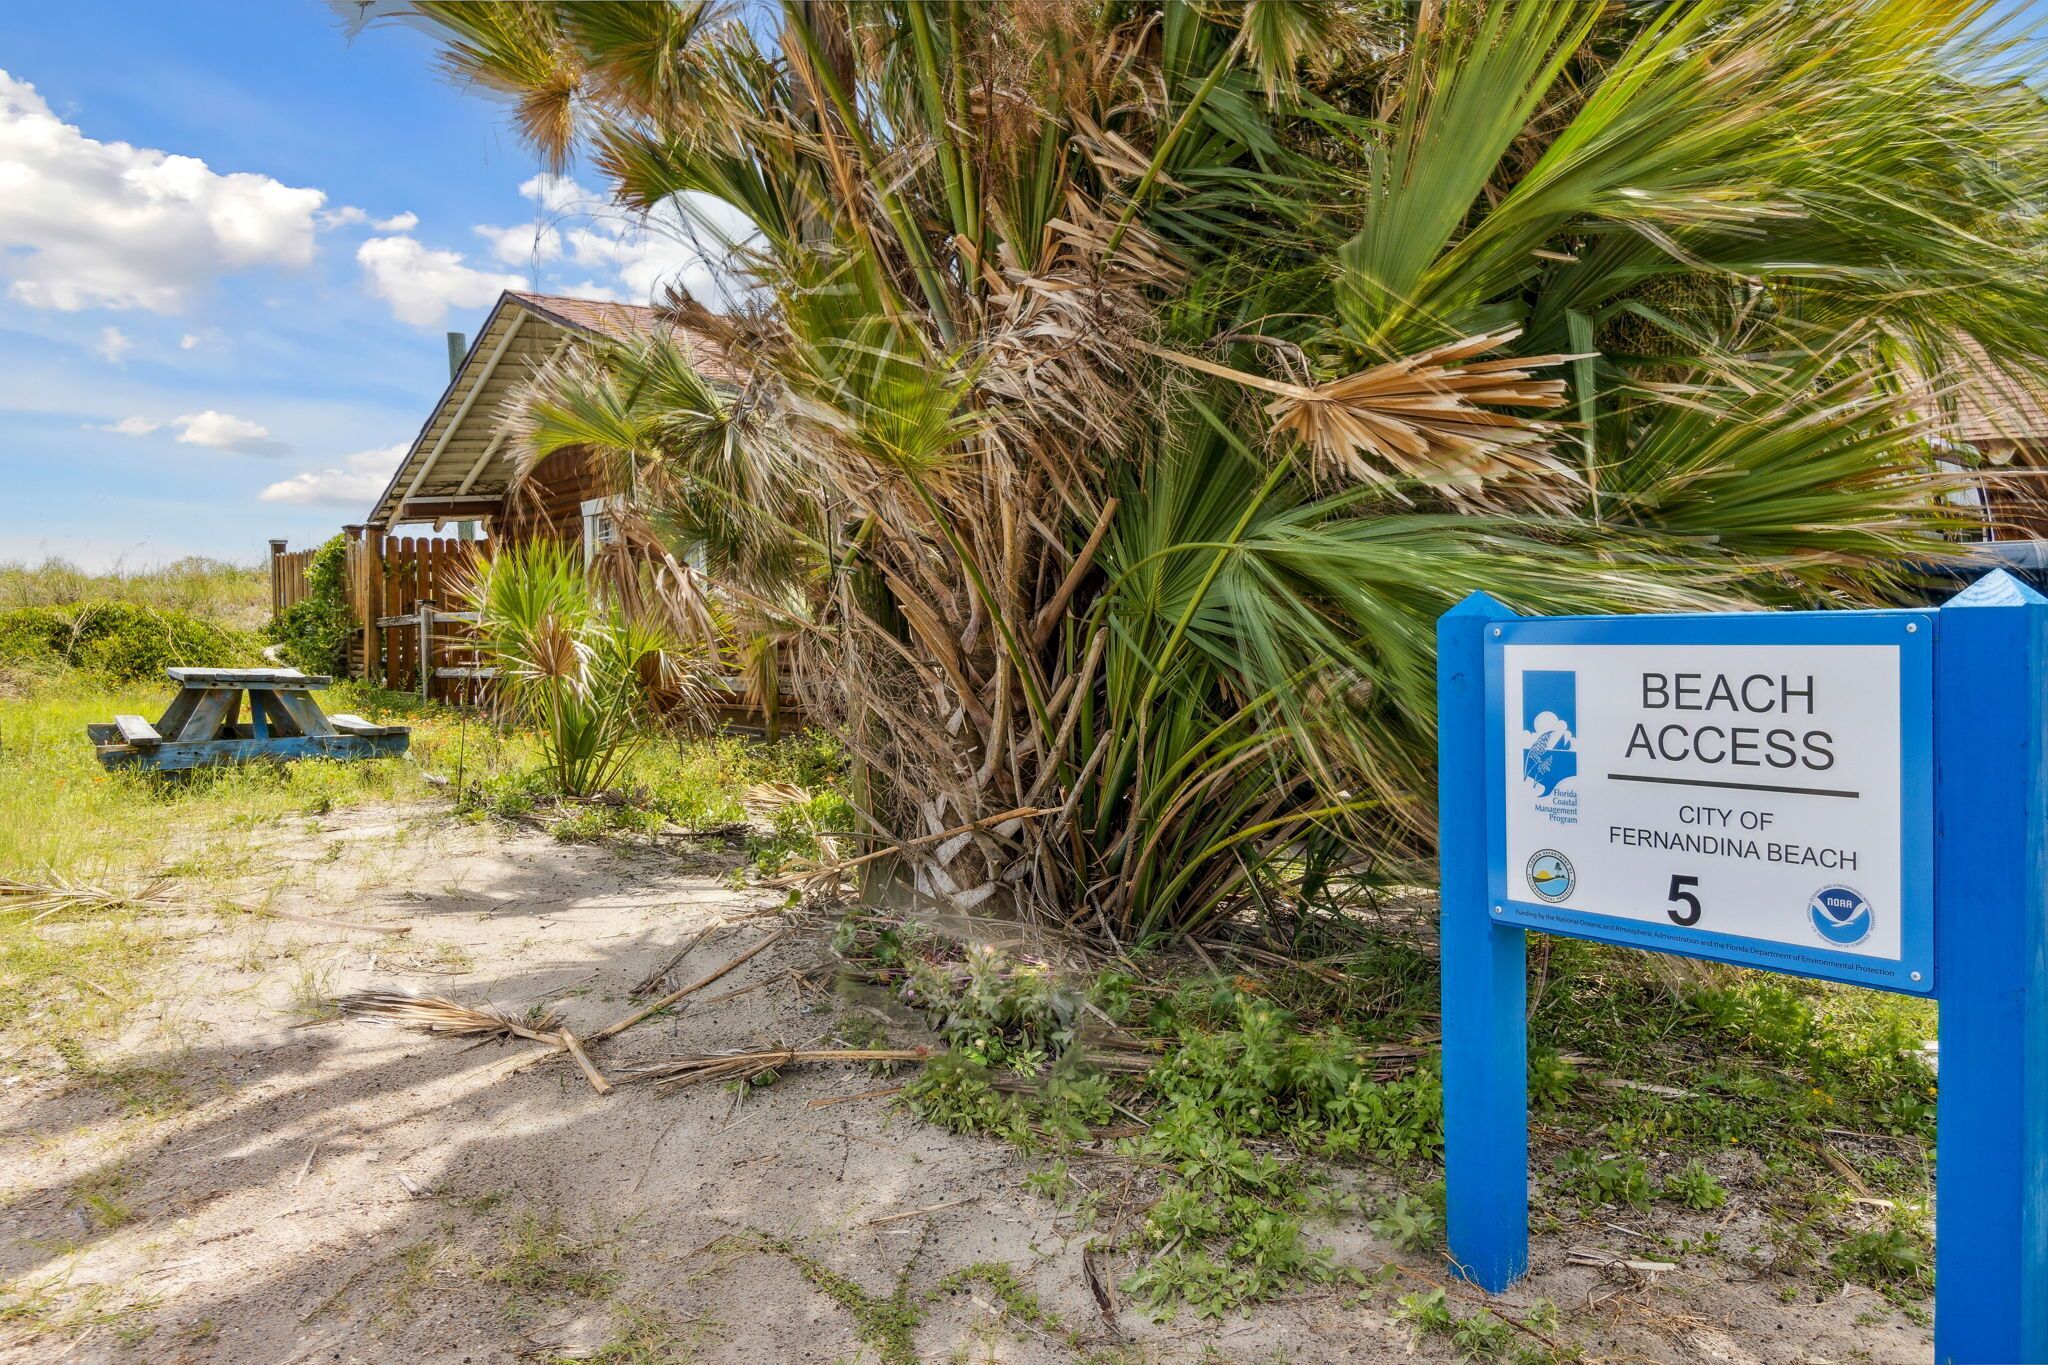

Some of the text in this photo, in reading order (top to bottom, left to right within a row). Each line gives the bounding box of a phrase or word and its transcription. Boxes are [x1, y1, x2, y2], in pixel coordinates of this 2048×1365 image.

[1642, 672, 1814, 715] BEACH
[1624, 723, 1835, 771] ACCESS
[1552, 798, 1577, 806] Coastal
[1553, 789, 1577, 798] Florida
[1535, 804, 1577, 815] Management
[1549, 814, 1577, 824] Program
[1679, 805, 1774, 831] CITY OF
[1609, 826, 1858, 871] FERNANDINA BEACH
[1667, 874, 1701, 926] 5
[1827, 897, 1852, 908] NOAA
[1515, 908, 1538, 919] Funding
[1555, 915, 1579, 925] National
[1579, 919, 1602, 930] Oceanic
[1602, 923, 1615, 931] and
[1615, 926, 1653, 938] Atmospheric
[1655, 932, 1699, 944] Administration
[1700, 939, 1713, 947] and
[1713, 941, 1726, 950] the
[1726, 944, 1749, 953] Florida
[1751, 948, 1791, 960] Department
[1802, 956, 1854, 970] Environmental
[1855, 965, 1895, 977] Protection
